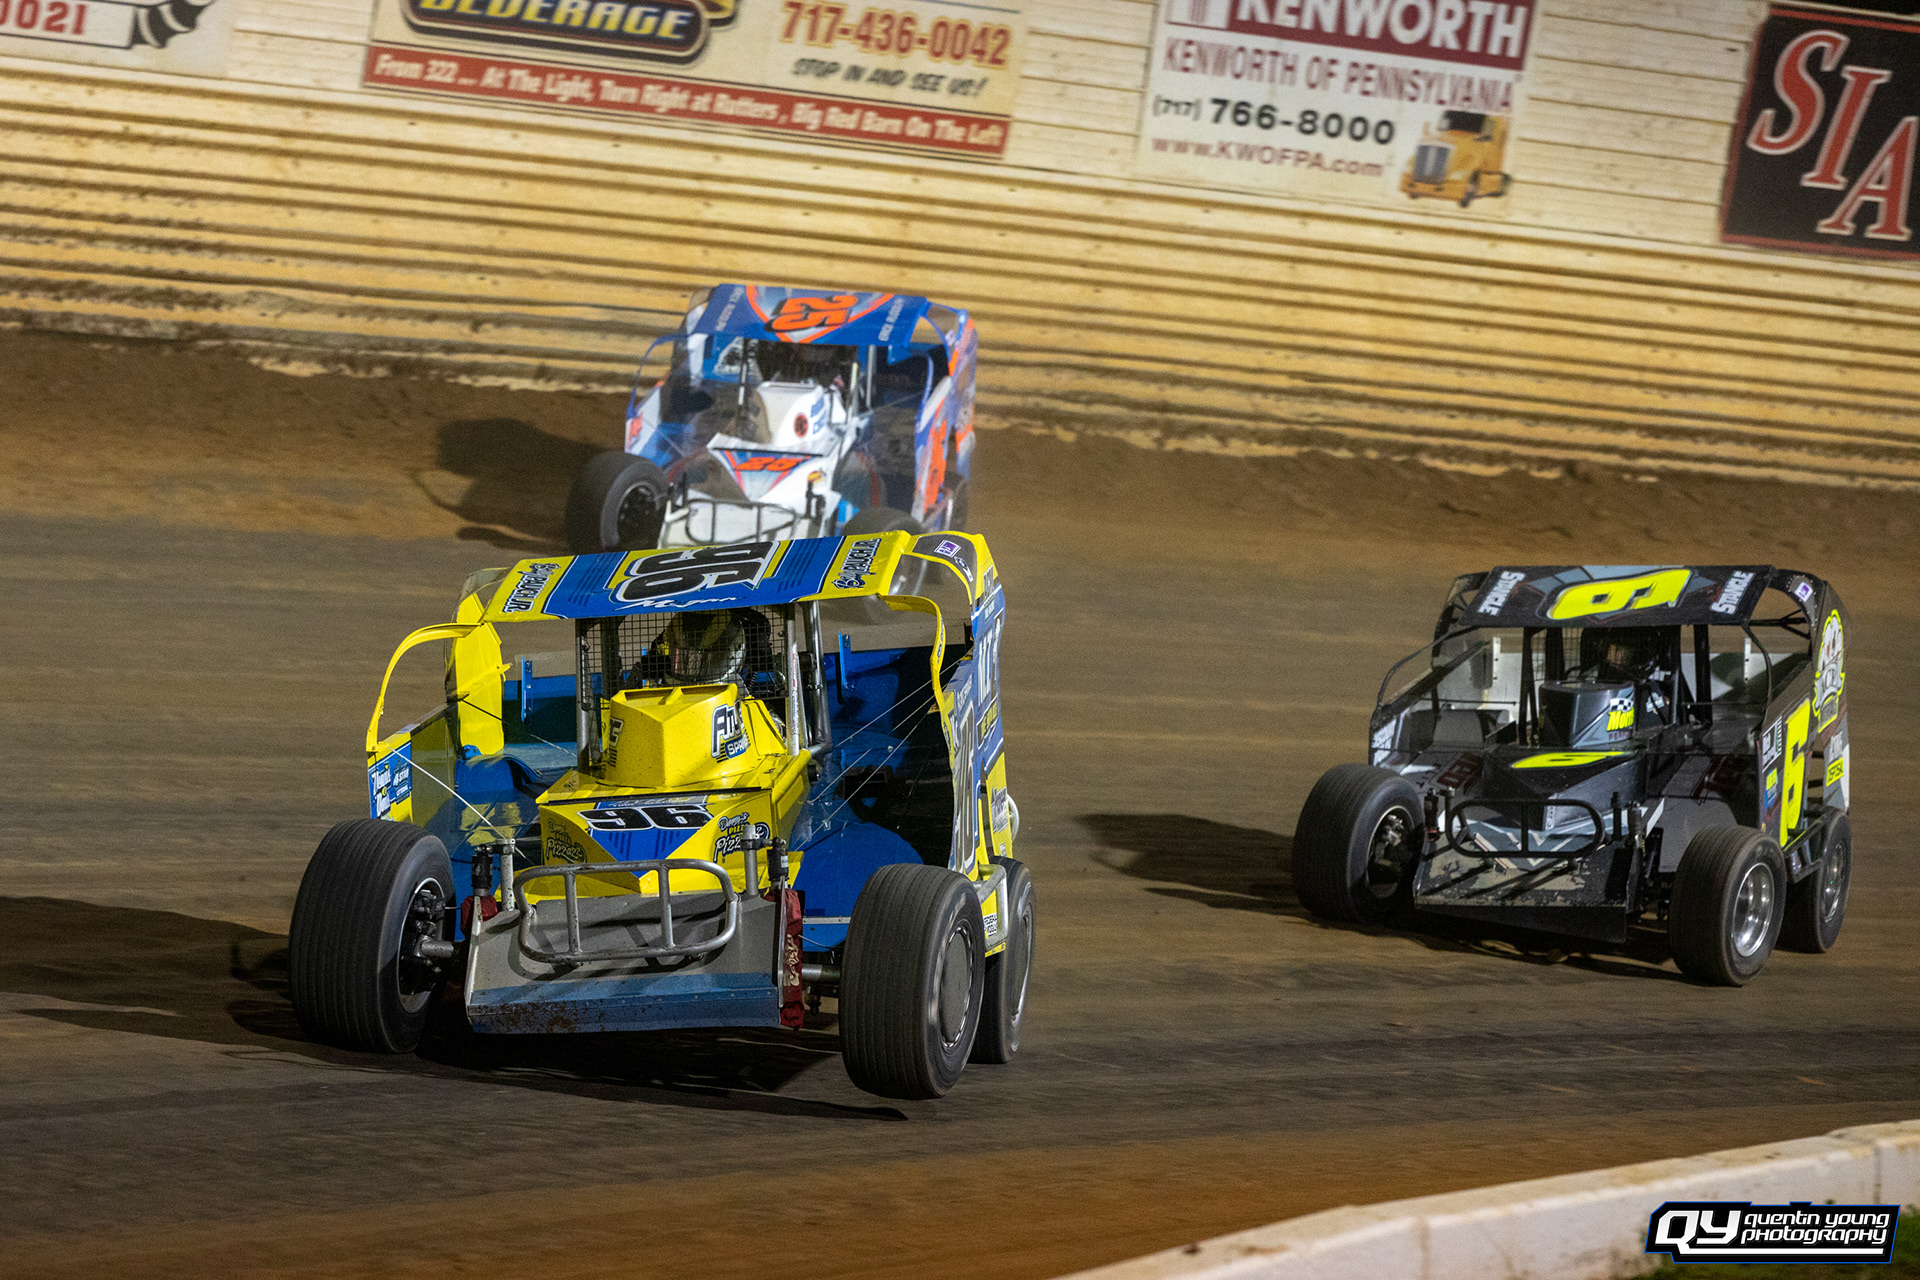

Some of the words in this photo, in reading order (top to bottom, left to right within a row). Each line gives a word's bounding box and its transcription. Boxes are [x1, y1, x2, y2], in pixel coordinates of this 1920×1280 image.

[780, 0, 1011, 68] 717-436-0042
[374, 53, 424, 79] From
[423, 59, 459, 84] 322
[479, 66, 506, 89] At
[507, 68, 543, 94] The
[600, 79, 640, 104] Turn
[640, 84, 691, 114] Right
[690, 92, 714, 113] at
[790, 102, 823, 131] Big
[824, 106, 862, 130] Red
[860, 111, 903, 135] Barn
[904, 116, 932, 138] On
[933, 119, 967, 142] The
[966, 123, 1002, 146] Left
[791, 57, 842, 78] STOP
[841, 64, 867, 82] IN
[865, 67, 907, 87] AND
[908, 72, 948, 92] SEE
[1163, 37, 1299, 86] KENWORTH
[1305, 55, 1340, 91] OF
[1343, 61, 1514, 113] PENNSYLVANIA
[1152, 95, 1202, 122] (717)
[1210, 97, 1395, 146] 766-8000
[1150, 138, 1383, 178] www.KWOFPA.com
[613, 540, 780, 603] 96
[840, 548, 877, 572] PAUCH
[509, 574, 550, 600] PAUCH
[1780, 698, 1811, 847] 6
[576, 804, 715, 831] 96
